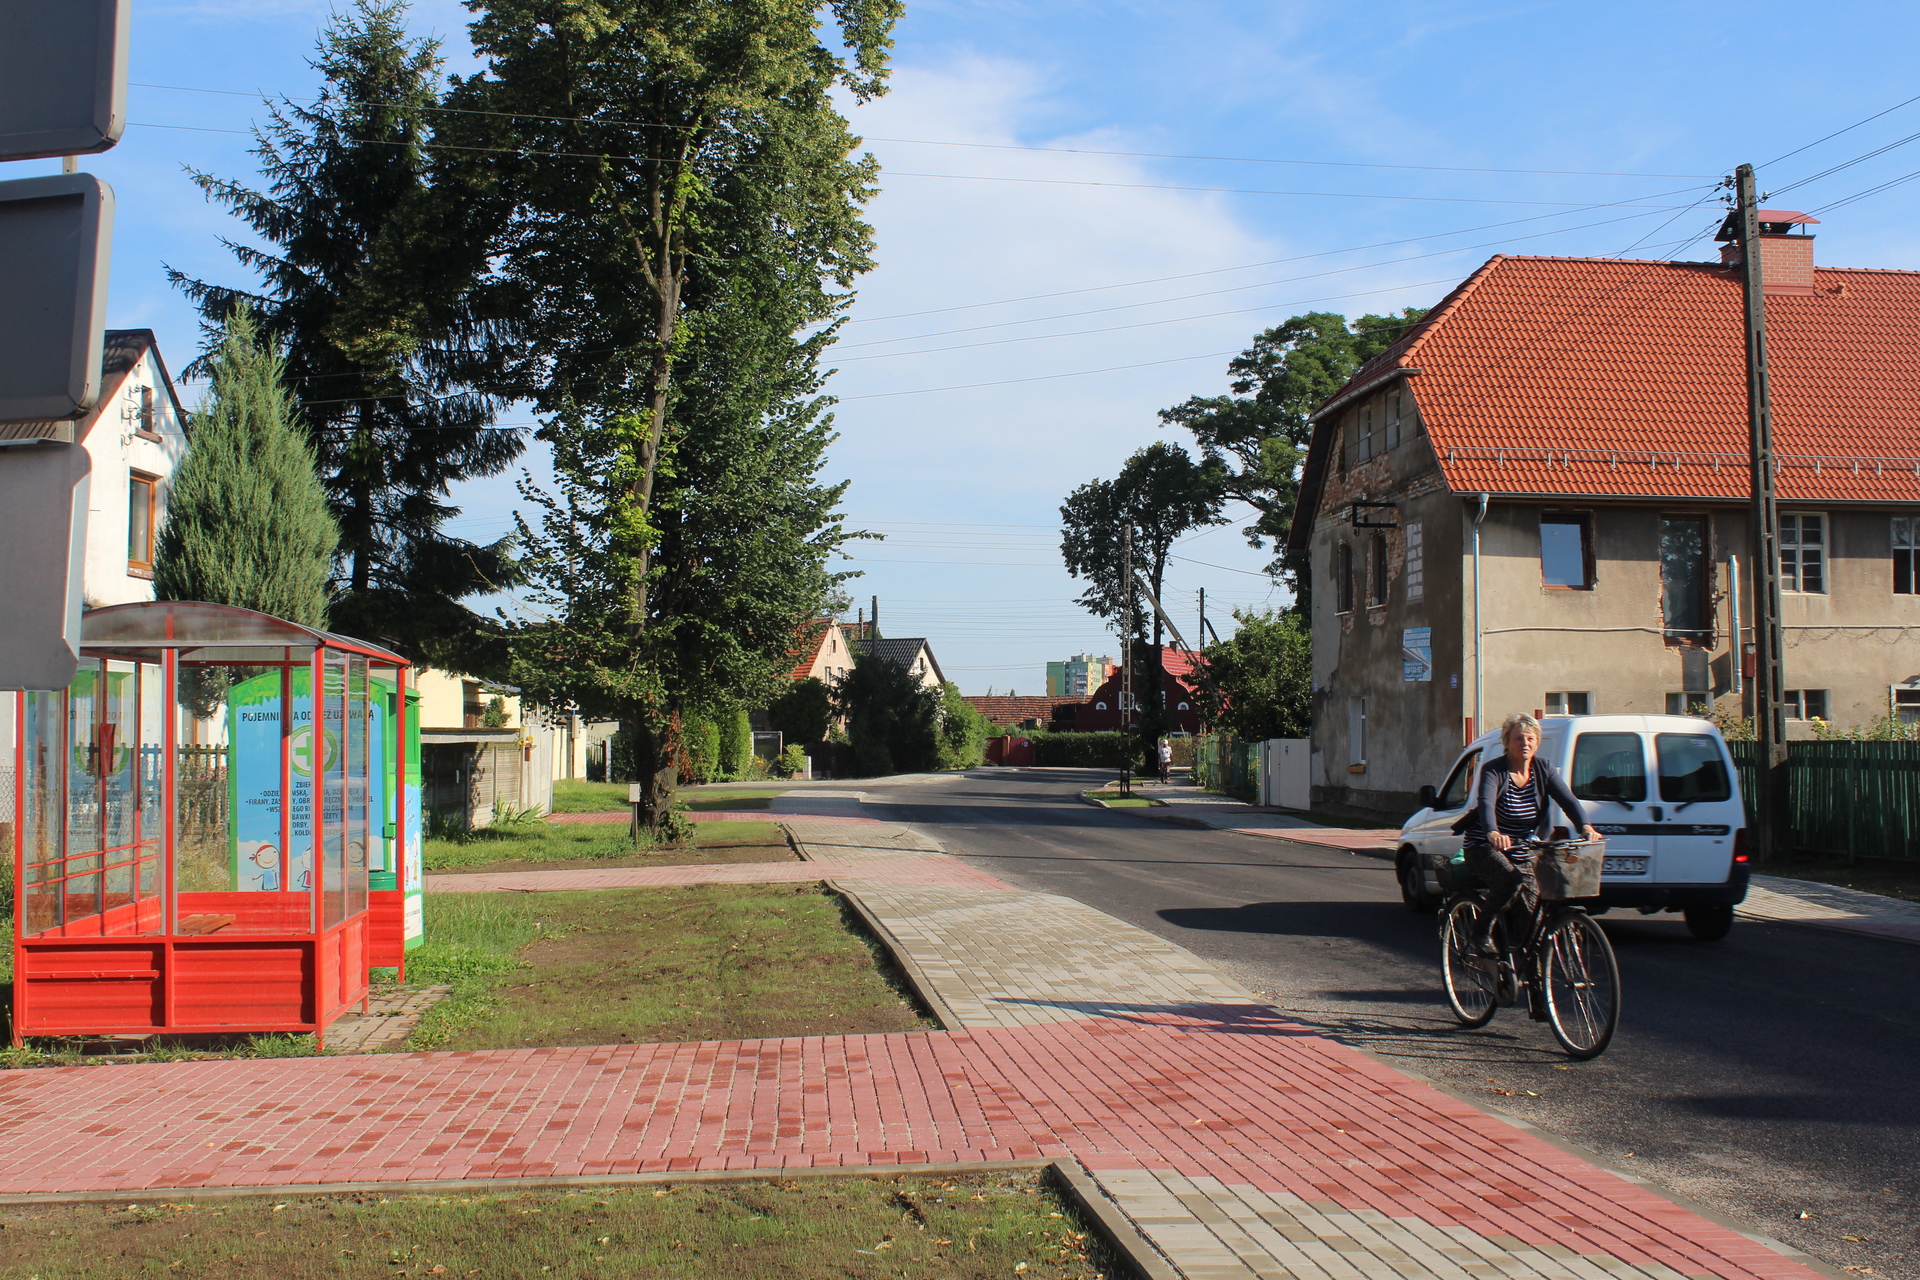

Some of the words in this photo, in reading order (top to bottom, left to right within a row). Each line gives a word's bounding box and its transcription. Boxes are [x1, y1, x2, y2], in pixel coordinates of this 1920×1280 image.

[263, 790, 281, 798] ODZIE
[248, 798, 271, 806] FIRANY,
[291, 813, 312, 821] BAWKI
[292, 821, 310, 829] ORBY,
